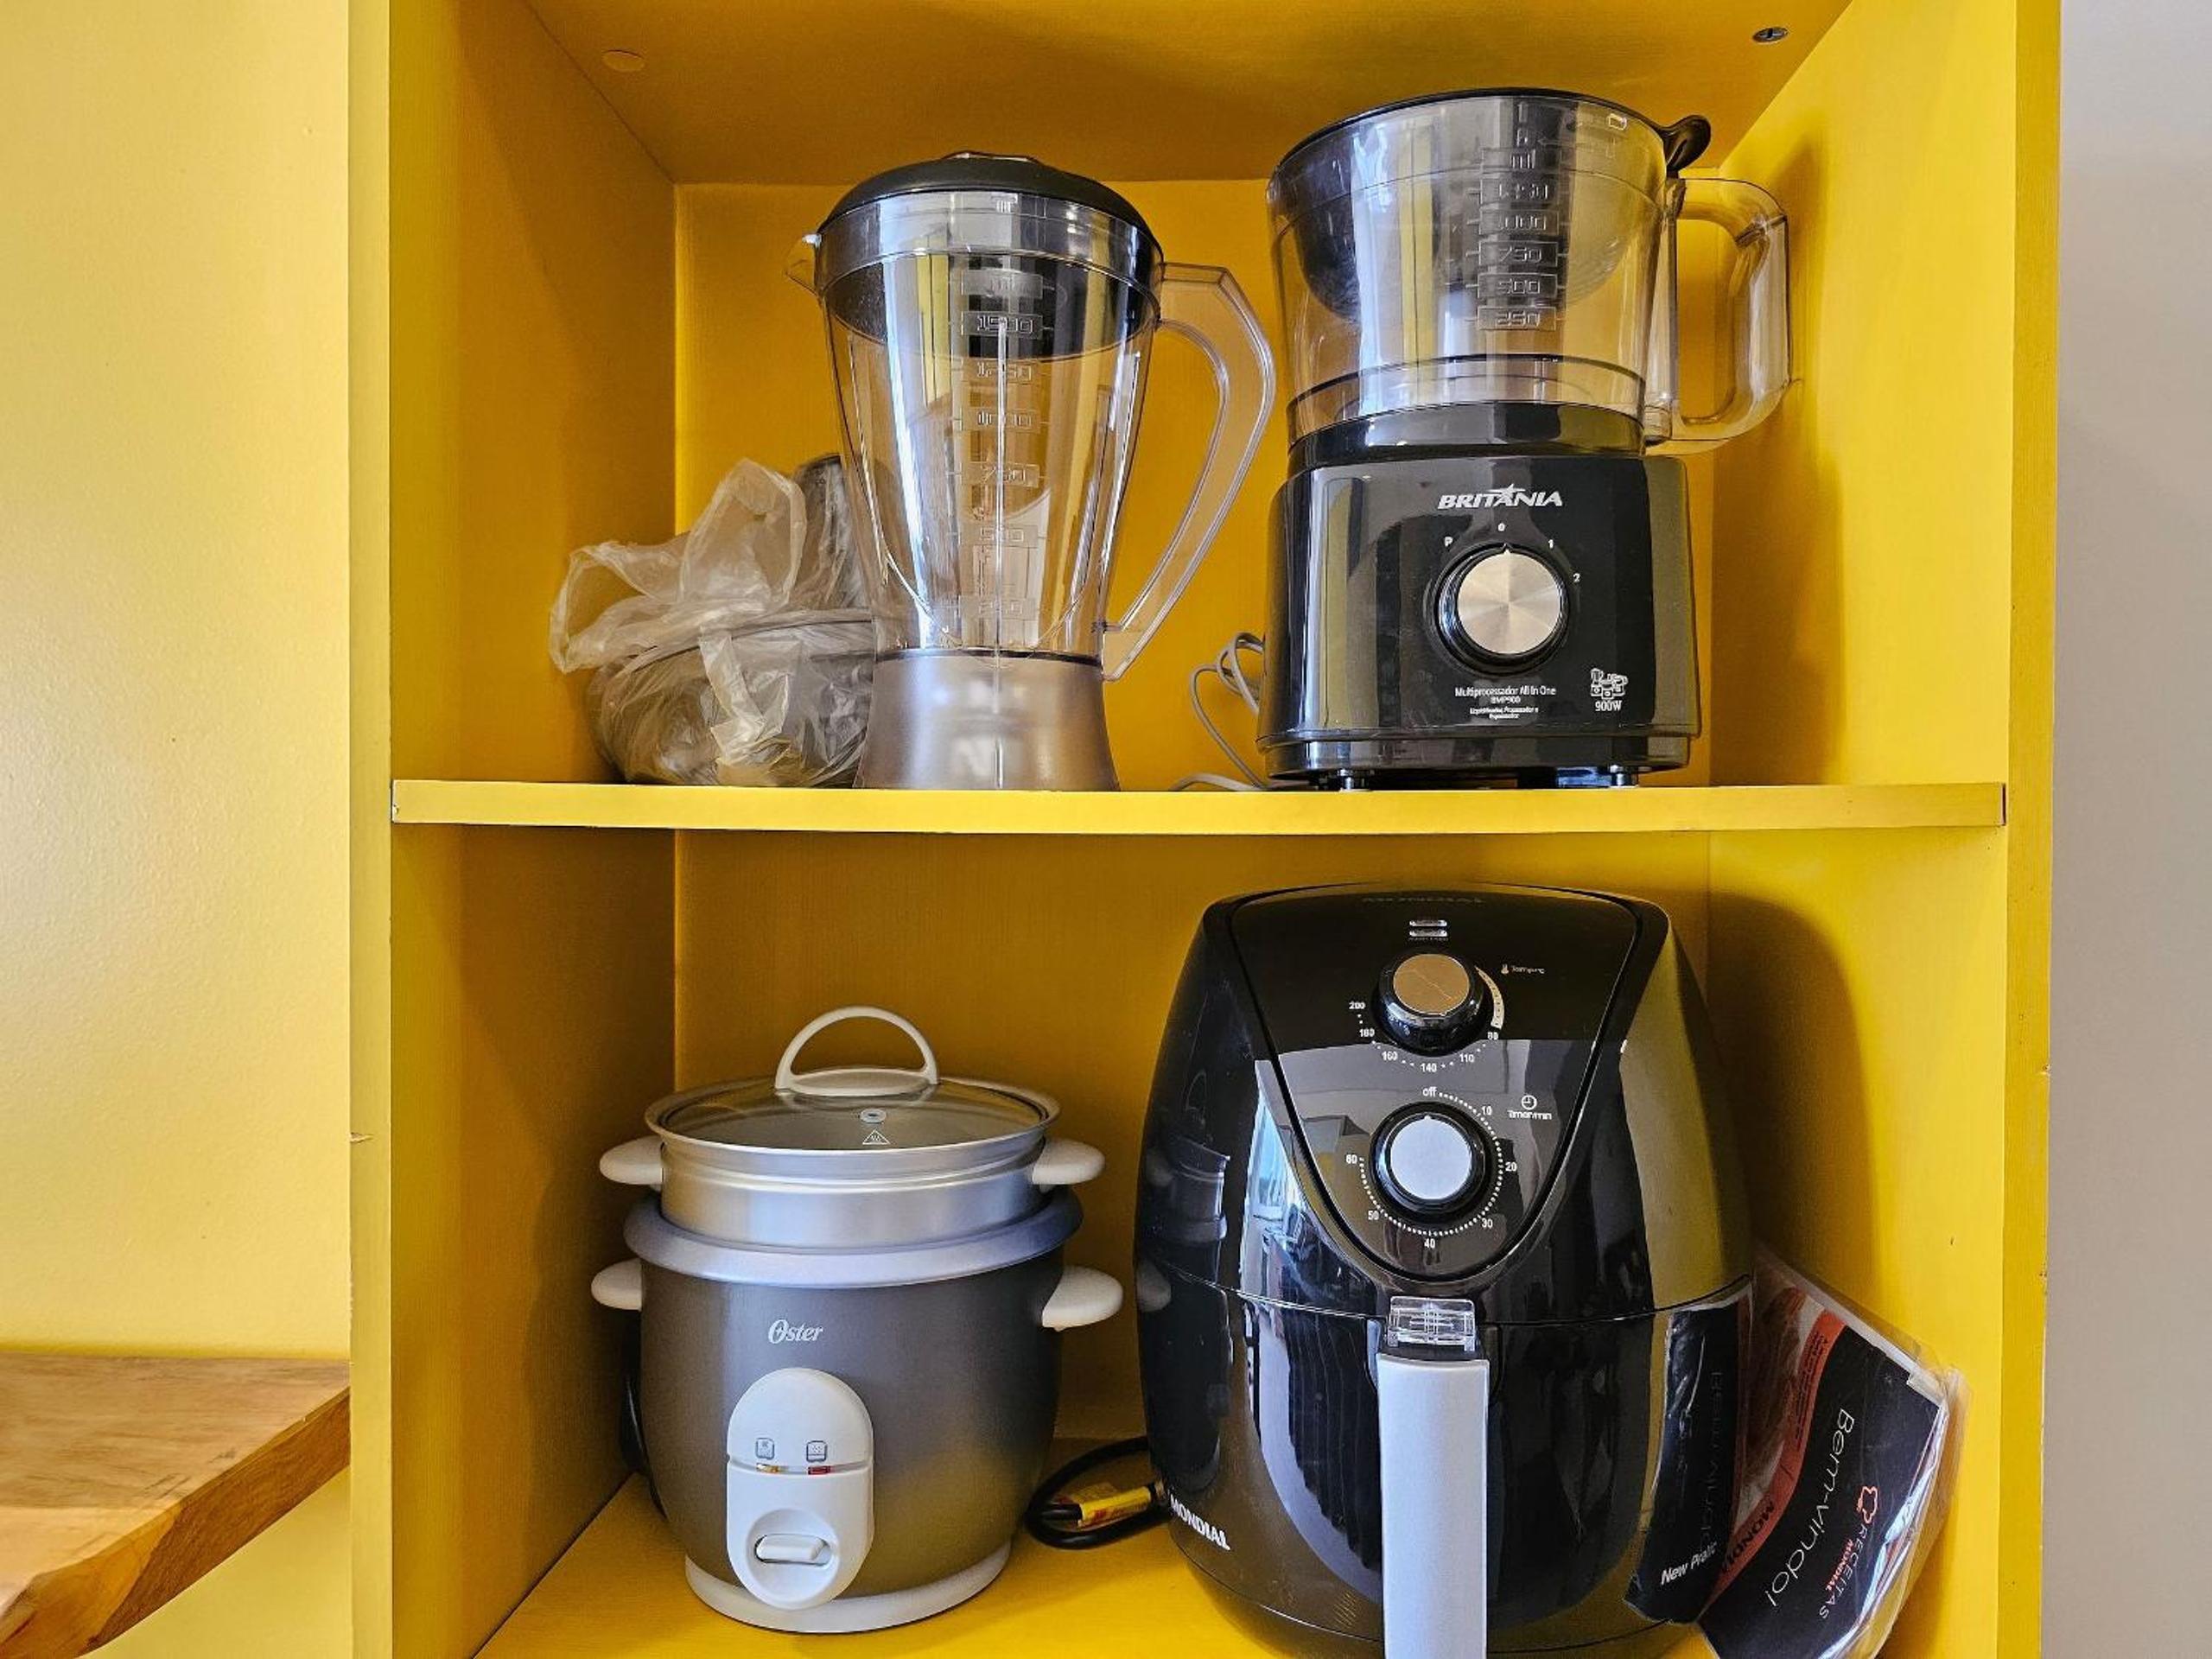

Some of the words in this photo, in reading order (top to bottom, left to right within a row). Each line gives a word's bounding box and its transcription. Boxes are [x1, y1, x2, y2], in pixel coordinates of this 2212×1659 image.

[1498, 247, 1542, 264] 750
[1497, 279, 1541, 296] 500
[1497, 523, 1506, 532] 0
[1445, 536, 1453, 547] P
[1548, 538, 1554, 549] 1
[1573, 573, 1581, 584] 2
[1454, 686, 1518, 699] Multiprocessador
[1540, 685, 1556, 696] One
[1595, 700, 1623, 712] 900W
[1348, 1001, 1366, 1010] 200
[1382, 1051, 1398, 1061] 160
[1459, 1053, 1475, 1063] 110
[1421, 1063, 1437, 1073] 140
[1422, 1086, 1438, 1097] off
[1482, 1105, 1492, 1116] 10
[1345, 1154, 1357, 1165] 60
[1504, 1161, 1517, 1172] 20
[1368, 1210, 1379, 1221] 50
[1482, 1217, 1493, 1230] 30
[1424, 1237, 1435, 1249] 40
[767, 1319, 823, 1344] Oster
[1764, 1407, 1856, 1607] Bem-vindo!
[1169, 1491, 1231, 1551] MONDIAL
[1660, 1562, 1688, 1586] New
[1818, 1523, 1869, 1619] RECEITAS
